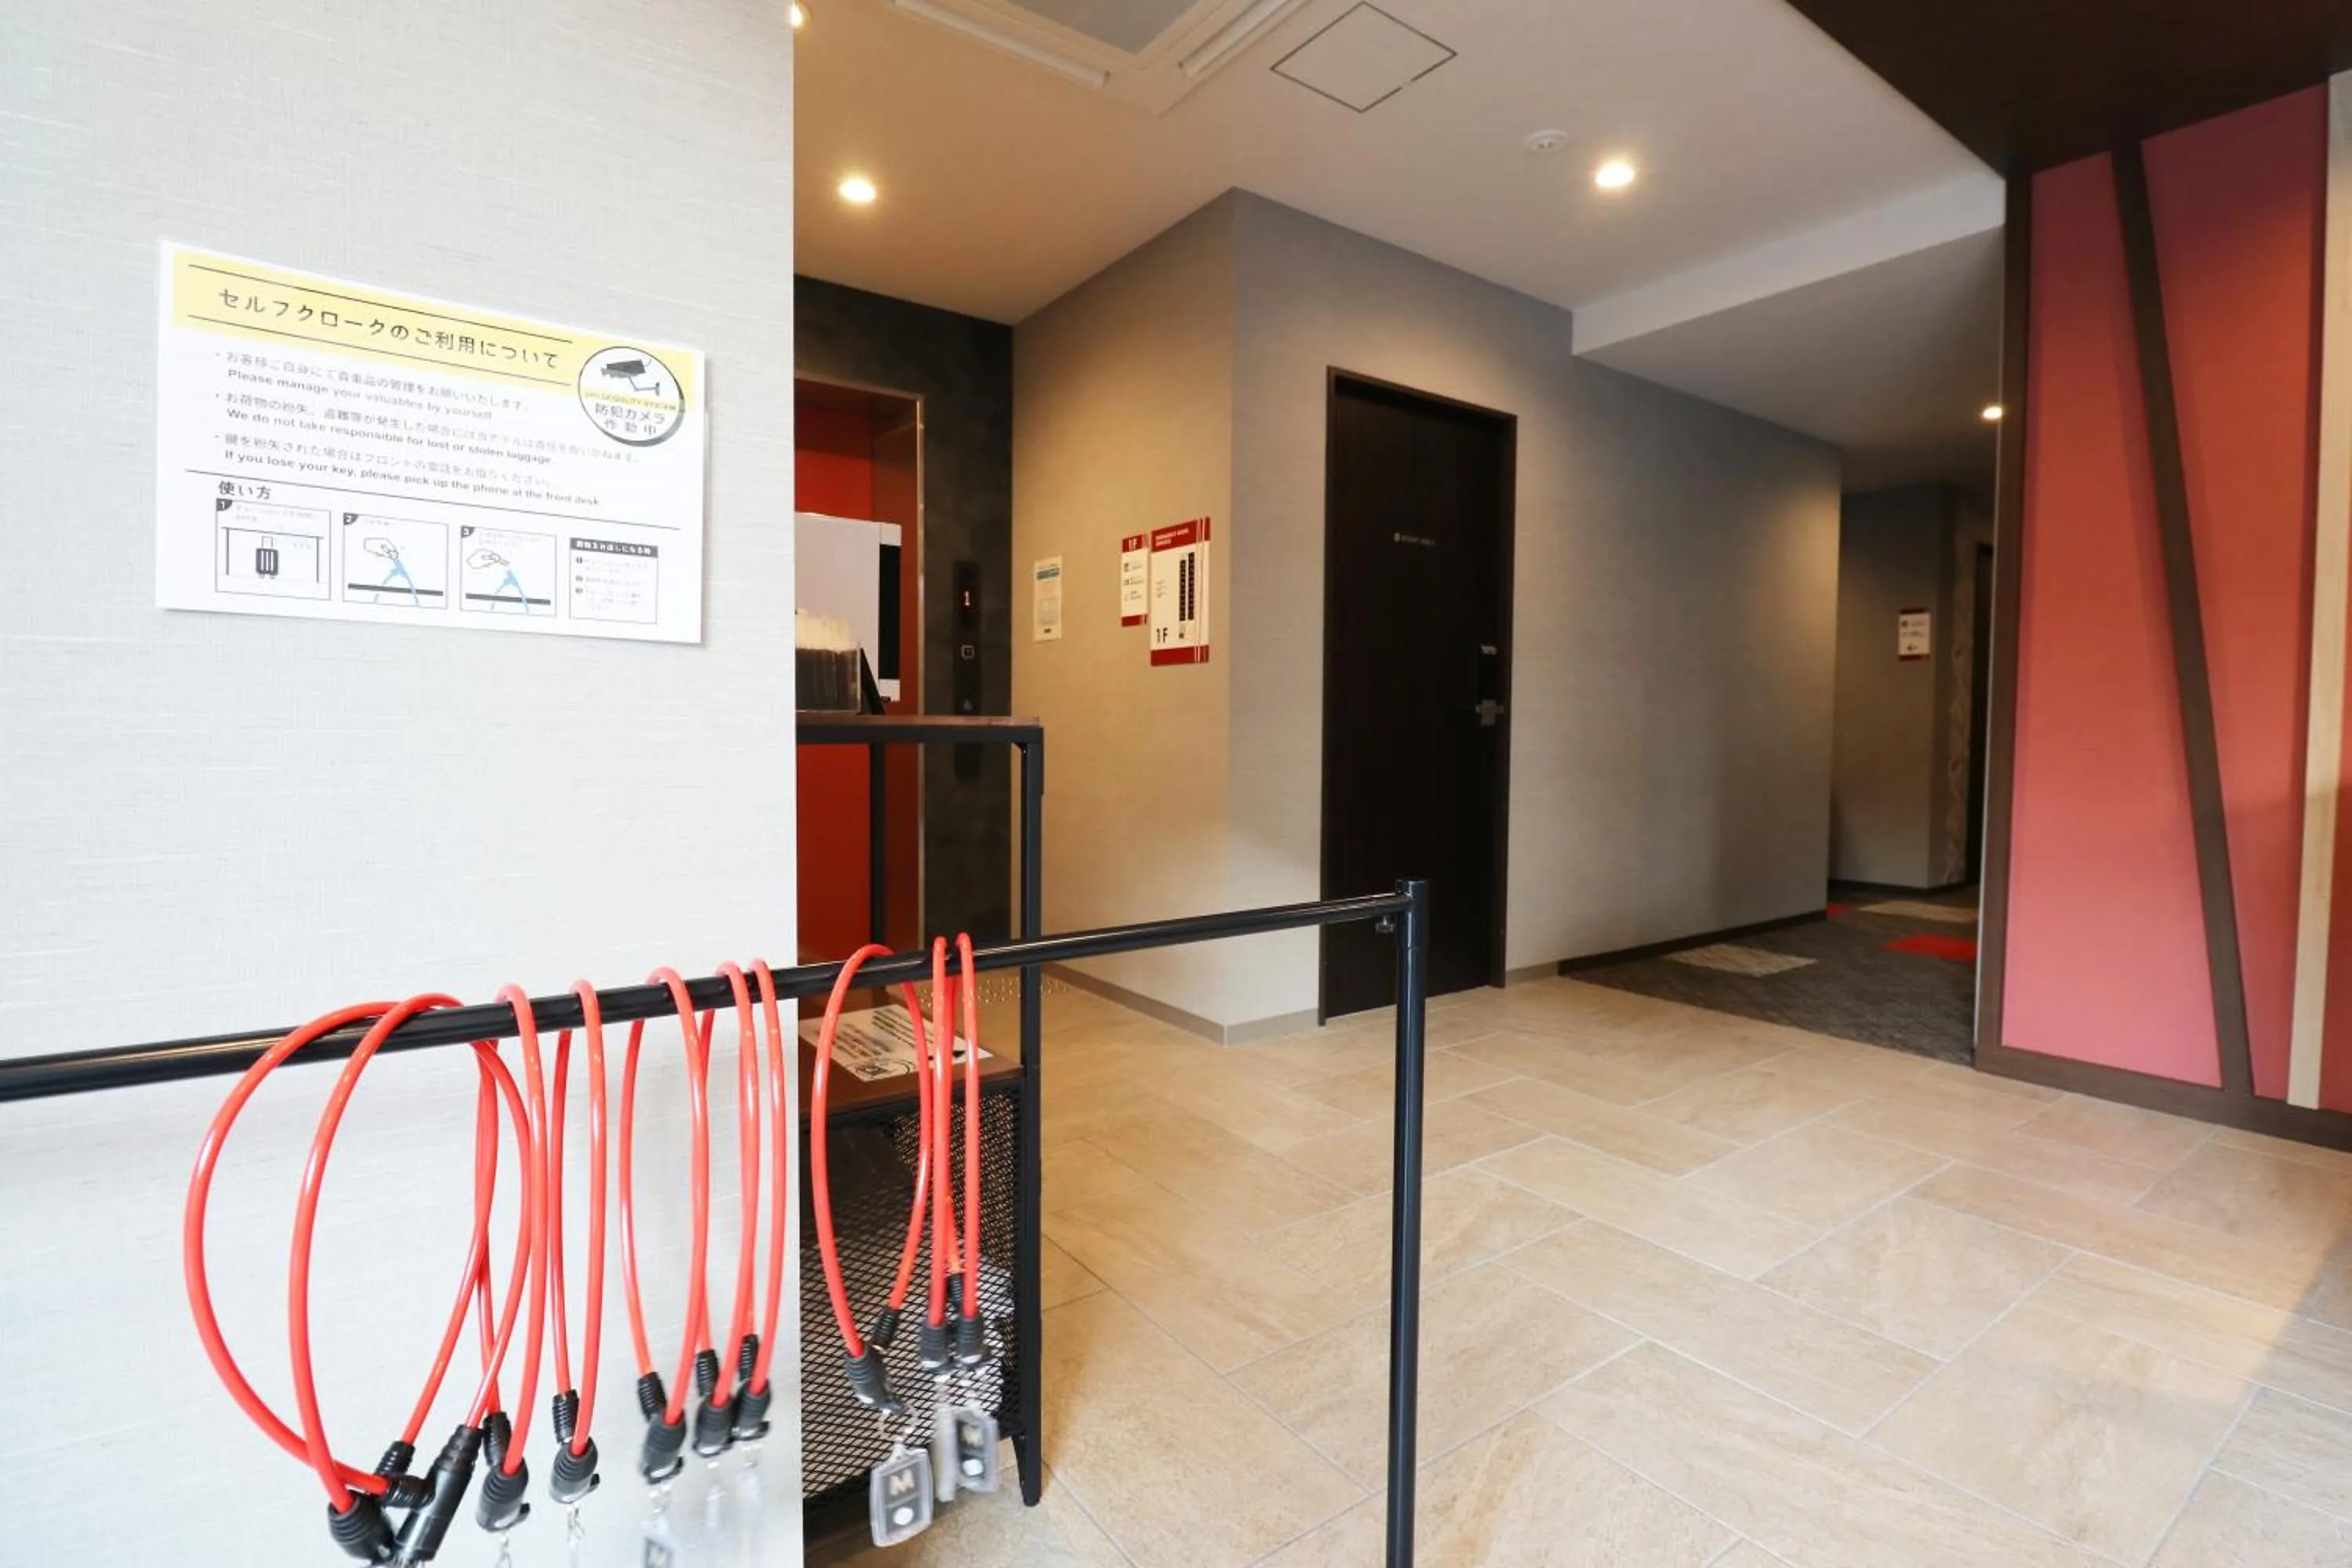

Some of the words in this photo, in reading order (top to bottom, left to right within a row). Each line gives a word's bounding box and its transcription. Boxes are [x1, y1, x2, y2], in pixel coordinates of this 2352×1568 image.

[219, 289, 558, 368] セルフクロークのご利用について
[227, 368, 273, 385] Please
[277, 378, 328, 394] manage
[333, 388, 360, 399] your
[365, 393, 423, 409] valuables
[427, 402, 441, 415] by
[595, 402, 665, 424] 防犯カメラ
[227, 407, 249, 420] We
[252, 413, 270, 424] do
[274, 416, 296, 427] not
[299, 420, 326, 432] take
[330, 426, 403, 443] responsible
[407, 435, 423, 446] for
[427, 438, 449, 450] lost
[452, 443, 464, 452] or
[468, 444, 504, 458] stolen
[224, 449, 234, 459] If
[238, 452, 263, 463] you
[267, 455, 296, 467] lose
[299, 461, 328, 472] your
[361, 470, 401, 481] please
[404, 474, 429, 485] pick
[434, 480, 448, 488] up
[451, 480, 470, 491] the
[473, 482, 509, 495] phone
[512, 488, 522, 497] at
[525, 489, 543, 499] the
[546, 492, 572, 503] front
[218, 480, 271, 499] 使い方
[220, 501, 226, 510] 1
[345, 515, 352, 524] 2
[1128, 538, 1138, 552] 1F
[964, 590, 971, 606] 1
[1156, 627, 1168, 643] 1F
[889, 1468, 915, 1496] M
